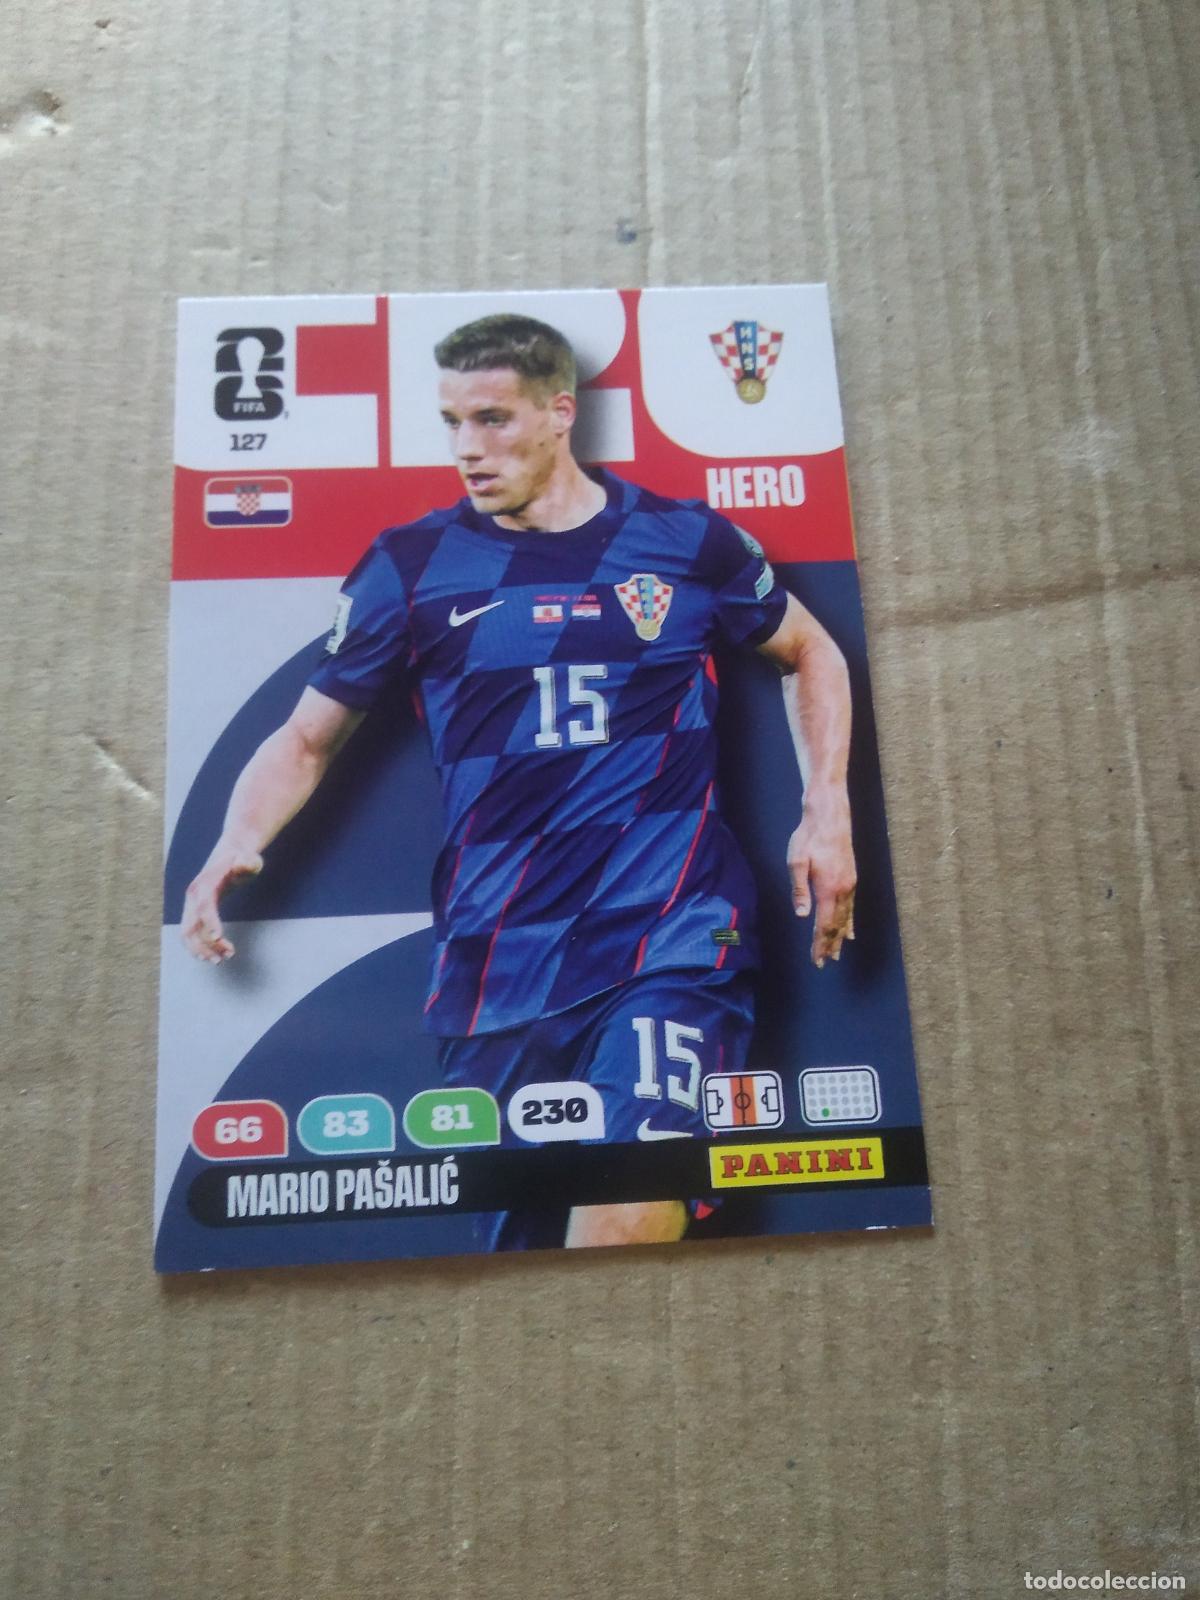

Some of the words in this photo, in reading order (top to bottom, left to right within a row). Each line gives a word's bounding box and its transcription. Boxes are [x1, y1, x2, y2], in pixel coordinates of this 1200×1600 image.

[233, 401, 266, 413] FIFA
[229, 433, 267, 451] 127
[706, 465, 806, 509] HERO
[533, 664, 610, 749] 15
[632, 1017, 704, 1113] 15
[322, 1110, 370, 1138] 83
[430, 1104, 474, 1132] 81
[521, 1097, 589, 1126] 230
[215, 1116, 263, 1145] 66
[720, 1147, 873, 1178] PANINI
[227, 1170, 330, 1218] MARIO
[336, 1155, 460, 1211] PAŠALIĆ
